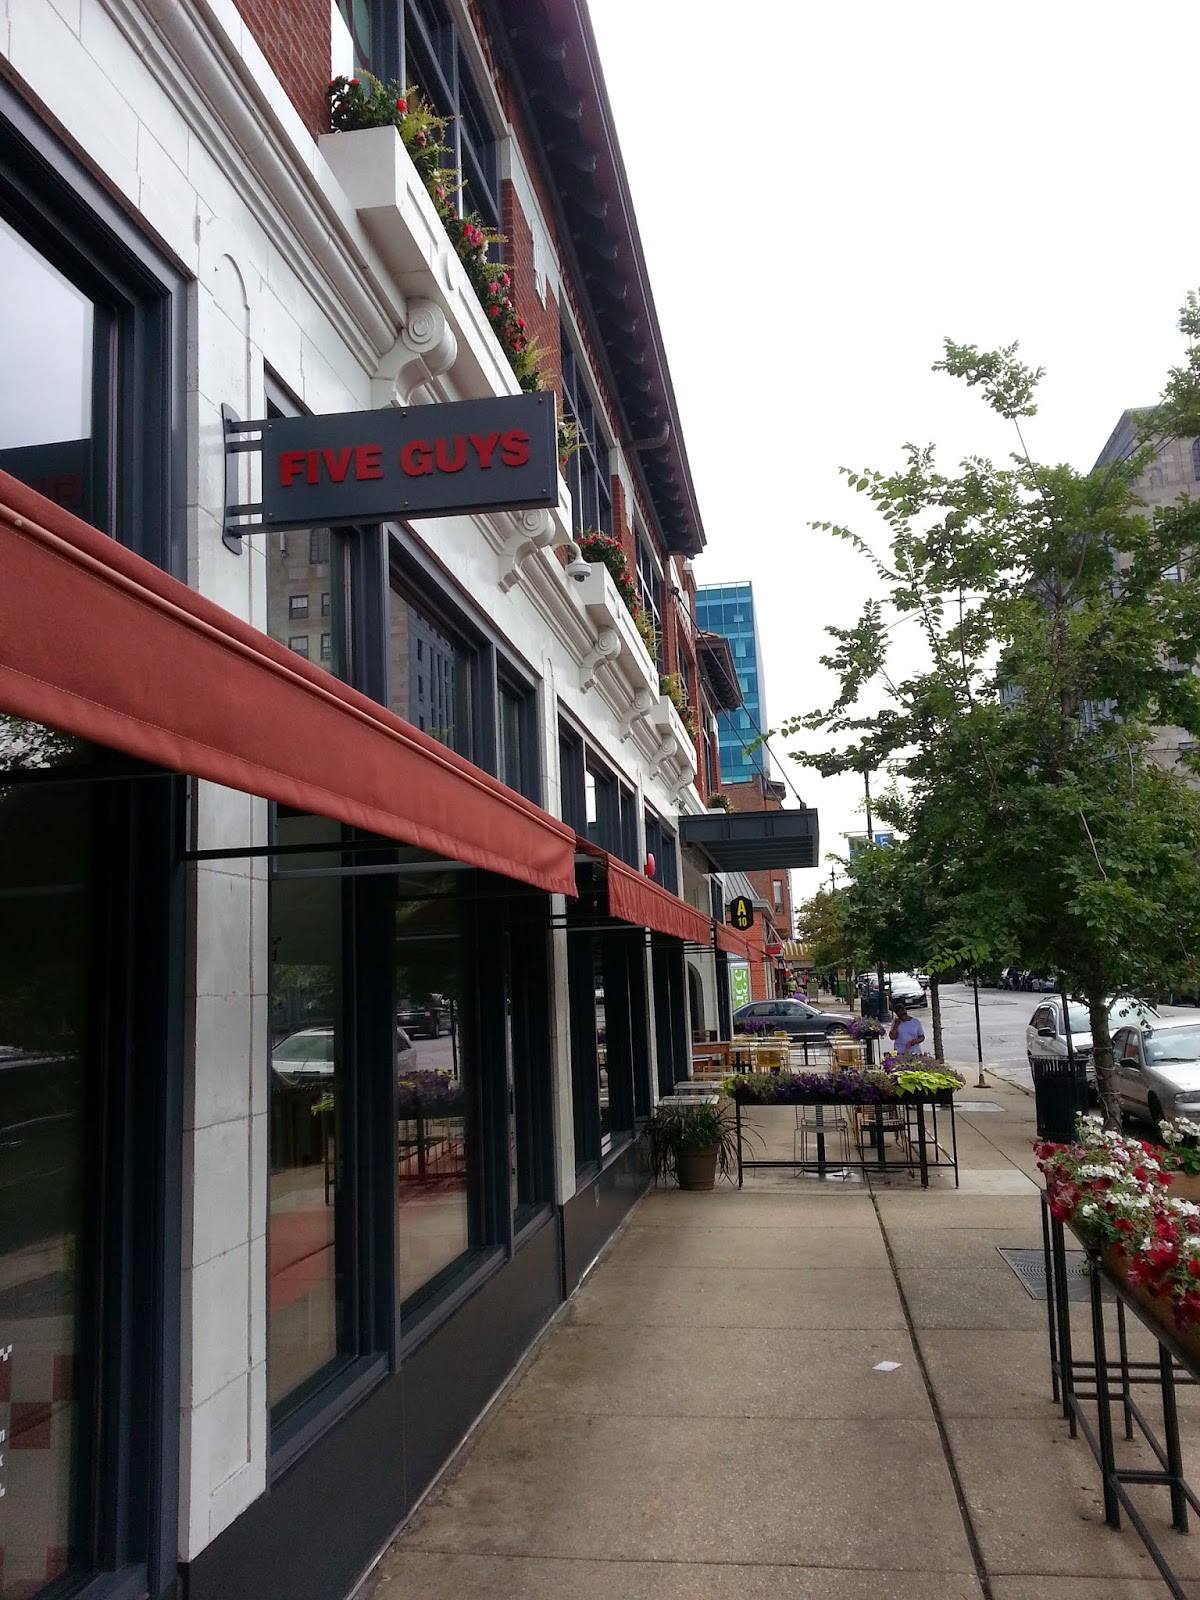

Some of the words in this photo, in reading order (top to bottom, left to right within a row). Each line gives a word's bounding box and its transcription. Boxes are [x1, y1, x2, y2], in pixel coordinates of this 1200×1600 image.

[280, 445, 383, 487] FIVE
[401, 430, 530, 477] GUYS
[737, 900, 746, 916] A
[738, 917, 747, 927] 10
